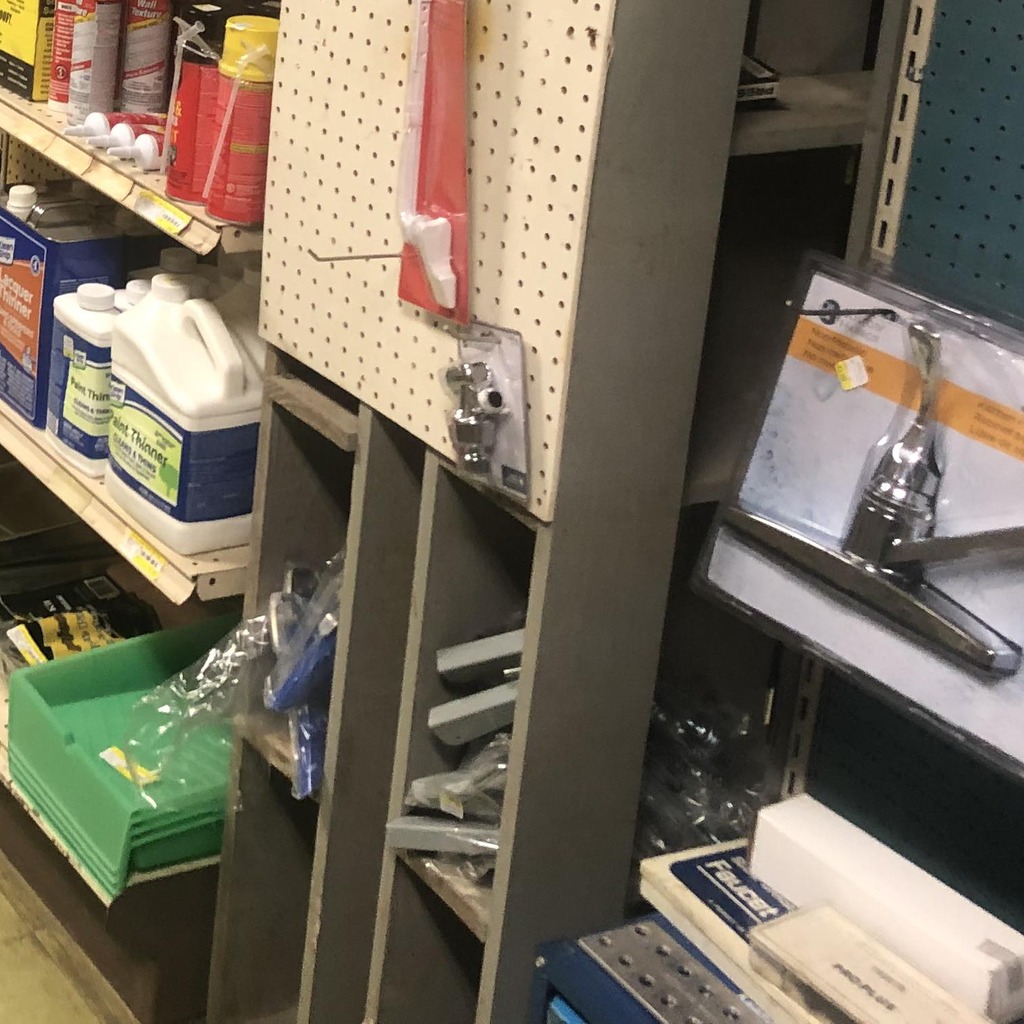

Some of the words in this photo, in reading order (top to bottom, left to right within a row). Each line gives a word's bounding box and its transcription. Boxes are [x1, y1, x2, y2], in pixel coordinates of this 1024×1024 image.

[131, 6, 163, 19] Texture
[88, 388, 111, 402] Thin
[112, 415, 129, 436] aint
[130, 427, 169, 468] Thinner
[704, 859, 779, 918] Faucet
